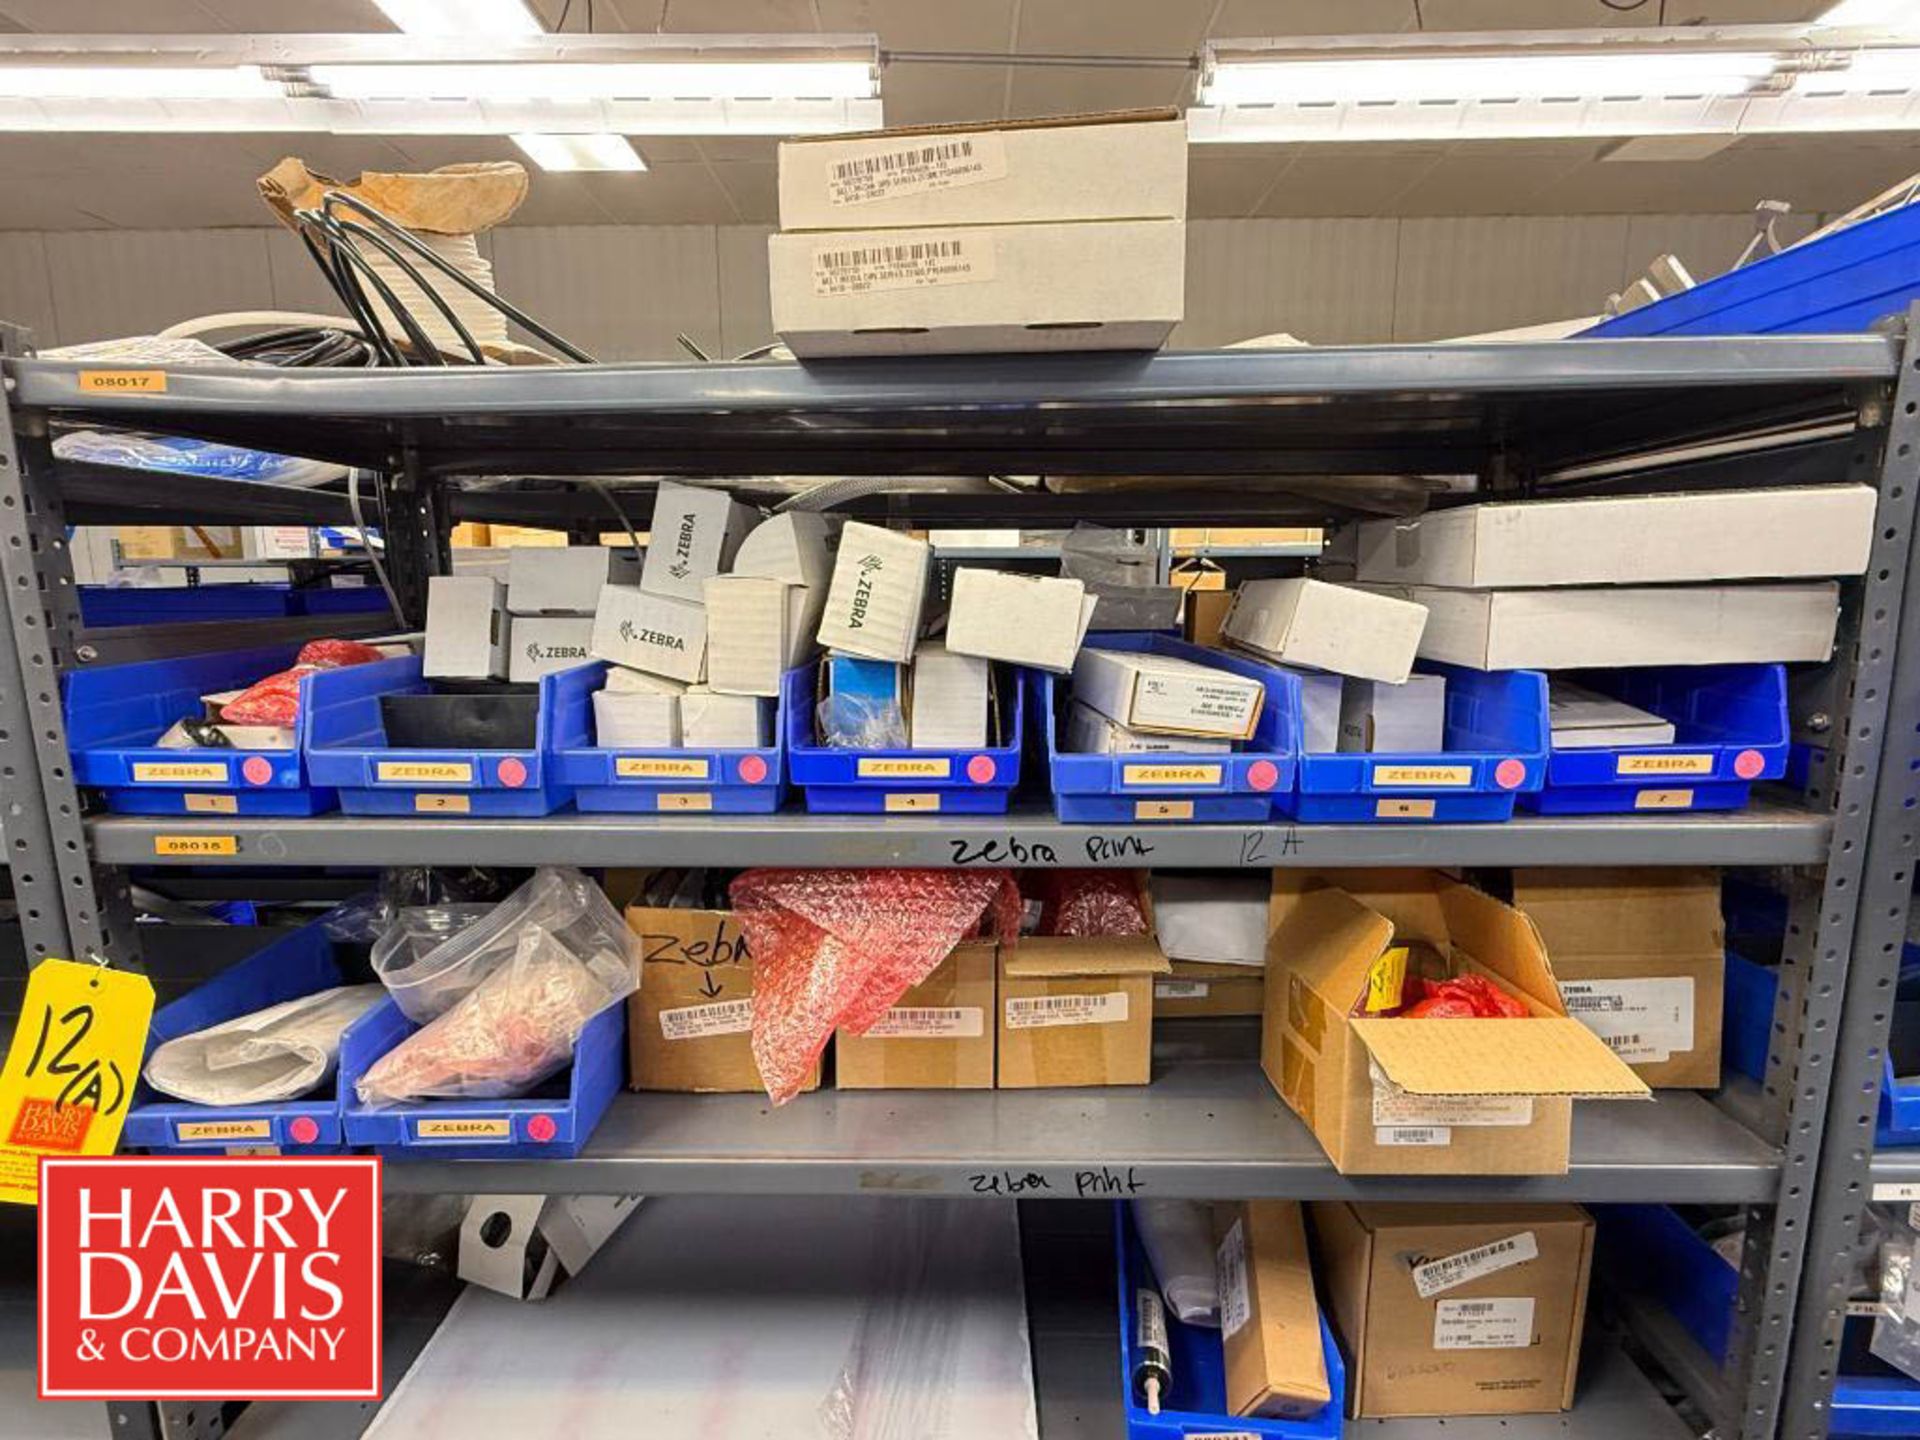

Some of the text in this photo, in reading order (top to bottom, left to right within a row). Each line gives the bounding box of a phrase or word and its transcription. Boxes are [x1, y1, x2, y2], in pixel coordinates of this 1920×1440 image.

[93, 377, 150, 387] 08017
[677, 513, 696, 560] ZEBRA
[848, 577, 877, 630] ZEBRA
[639, 628, 685, 651] ZEBRA
[546, 646, 587, 659] ZEBRA
[629, 763, 693, 773] ZEBRA
[1630, 758, 1697, 769] ZEBRA
[1137, 769, 1206, 779] ZEBRA
[1387, 770, 1456, 780] ZEBRA
[25, 1003, 94, 1078] 12
[56, 1058, 124, 1116] (A)
[191, 1124, 256, 1136] ZEBRA
[429, 1123, 496, 1132] ZEBRA
